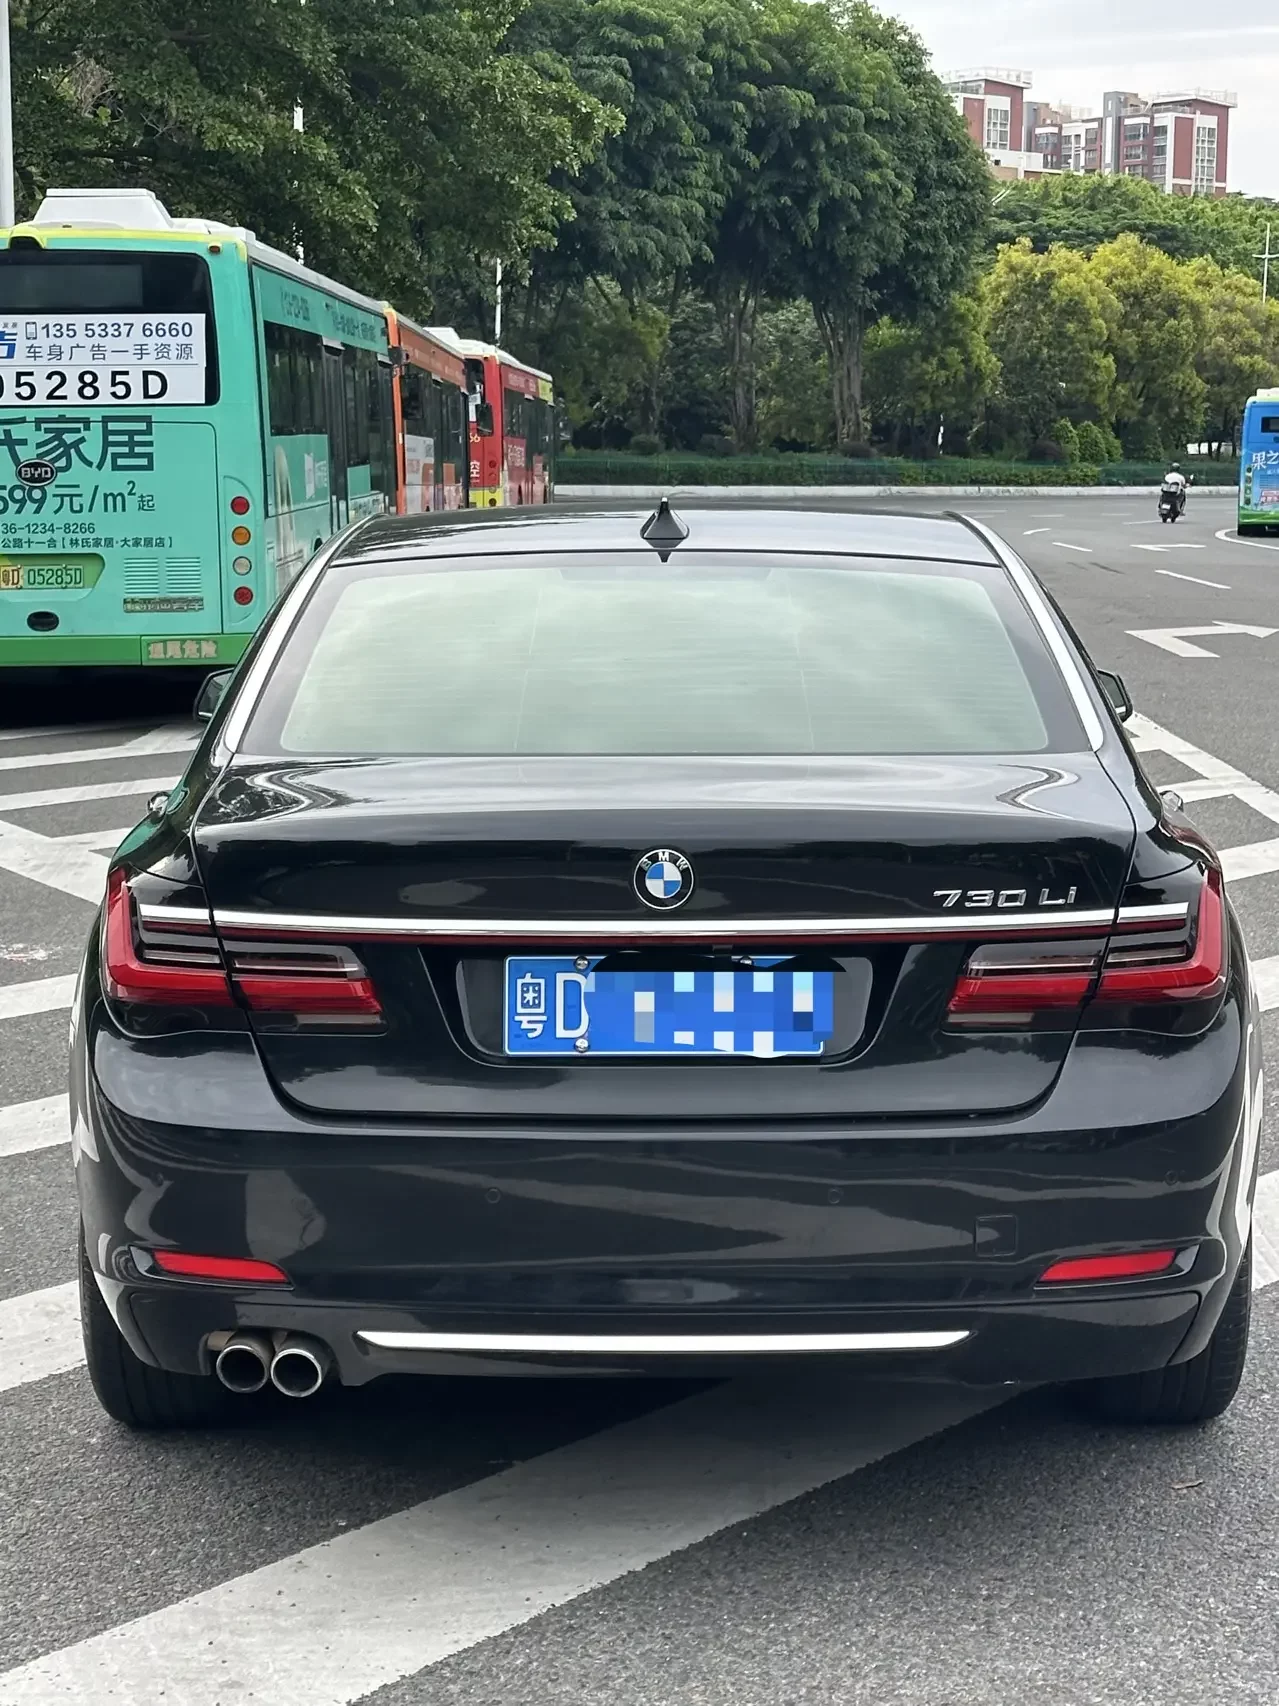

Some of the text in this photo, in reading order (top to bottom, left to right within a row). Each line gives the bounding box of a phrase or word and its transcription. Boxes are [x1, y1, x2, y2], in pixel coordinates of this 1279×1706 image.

[41, 322, 193, 338] 135 5337 6660
[25, 343, 195, 361] 车身广告一手资源
[0, 370, 168, 401] 5285D
[21, 467, 52, 479] BYD
[1, 522, 96, 534] 36-1234-8266
[27, 567, 82, 586] 05285D
[933, 886, 1077, 907] 730 Li
